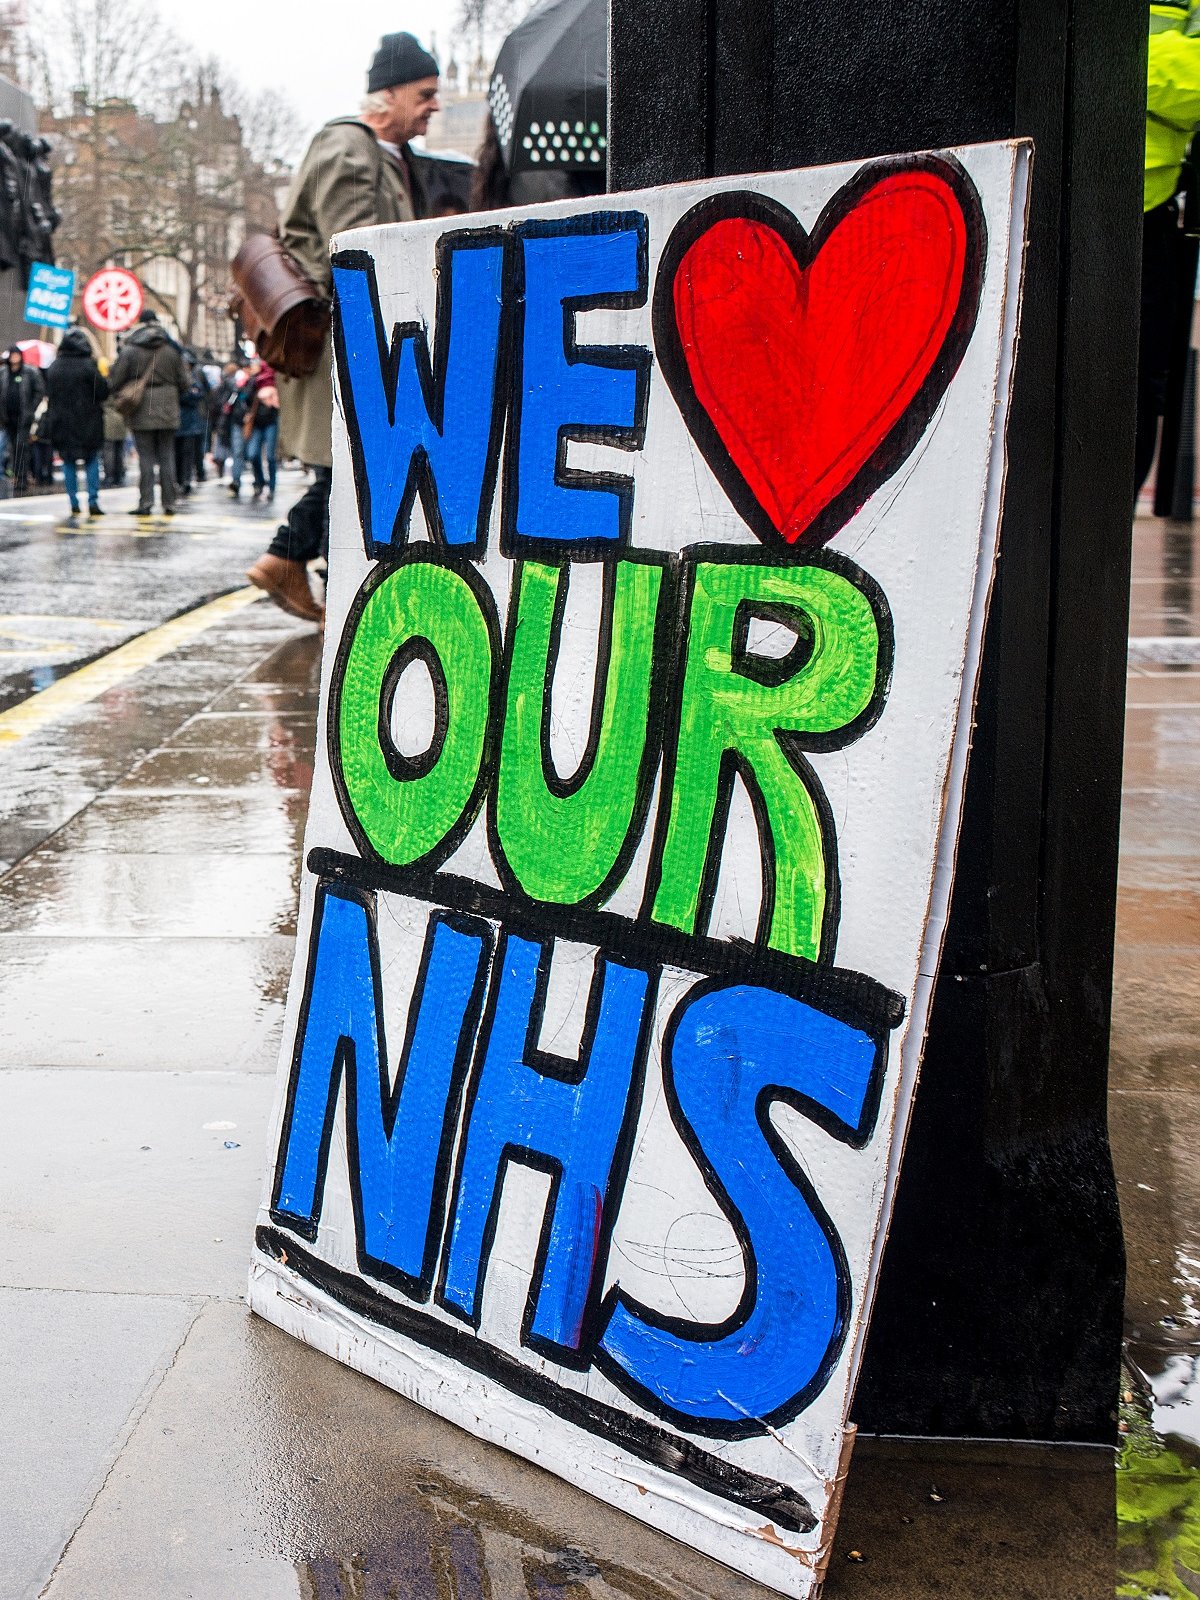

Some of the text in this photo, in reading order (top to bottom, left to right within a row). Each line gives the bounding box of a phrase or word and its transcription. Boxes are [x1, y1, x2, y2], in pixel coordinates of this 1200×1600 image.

[331, 210, 652, 561] WE
[328, 542, 892, 964] OUR
[270, 878, 890, 1442] NHS
